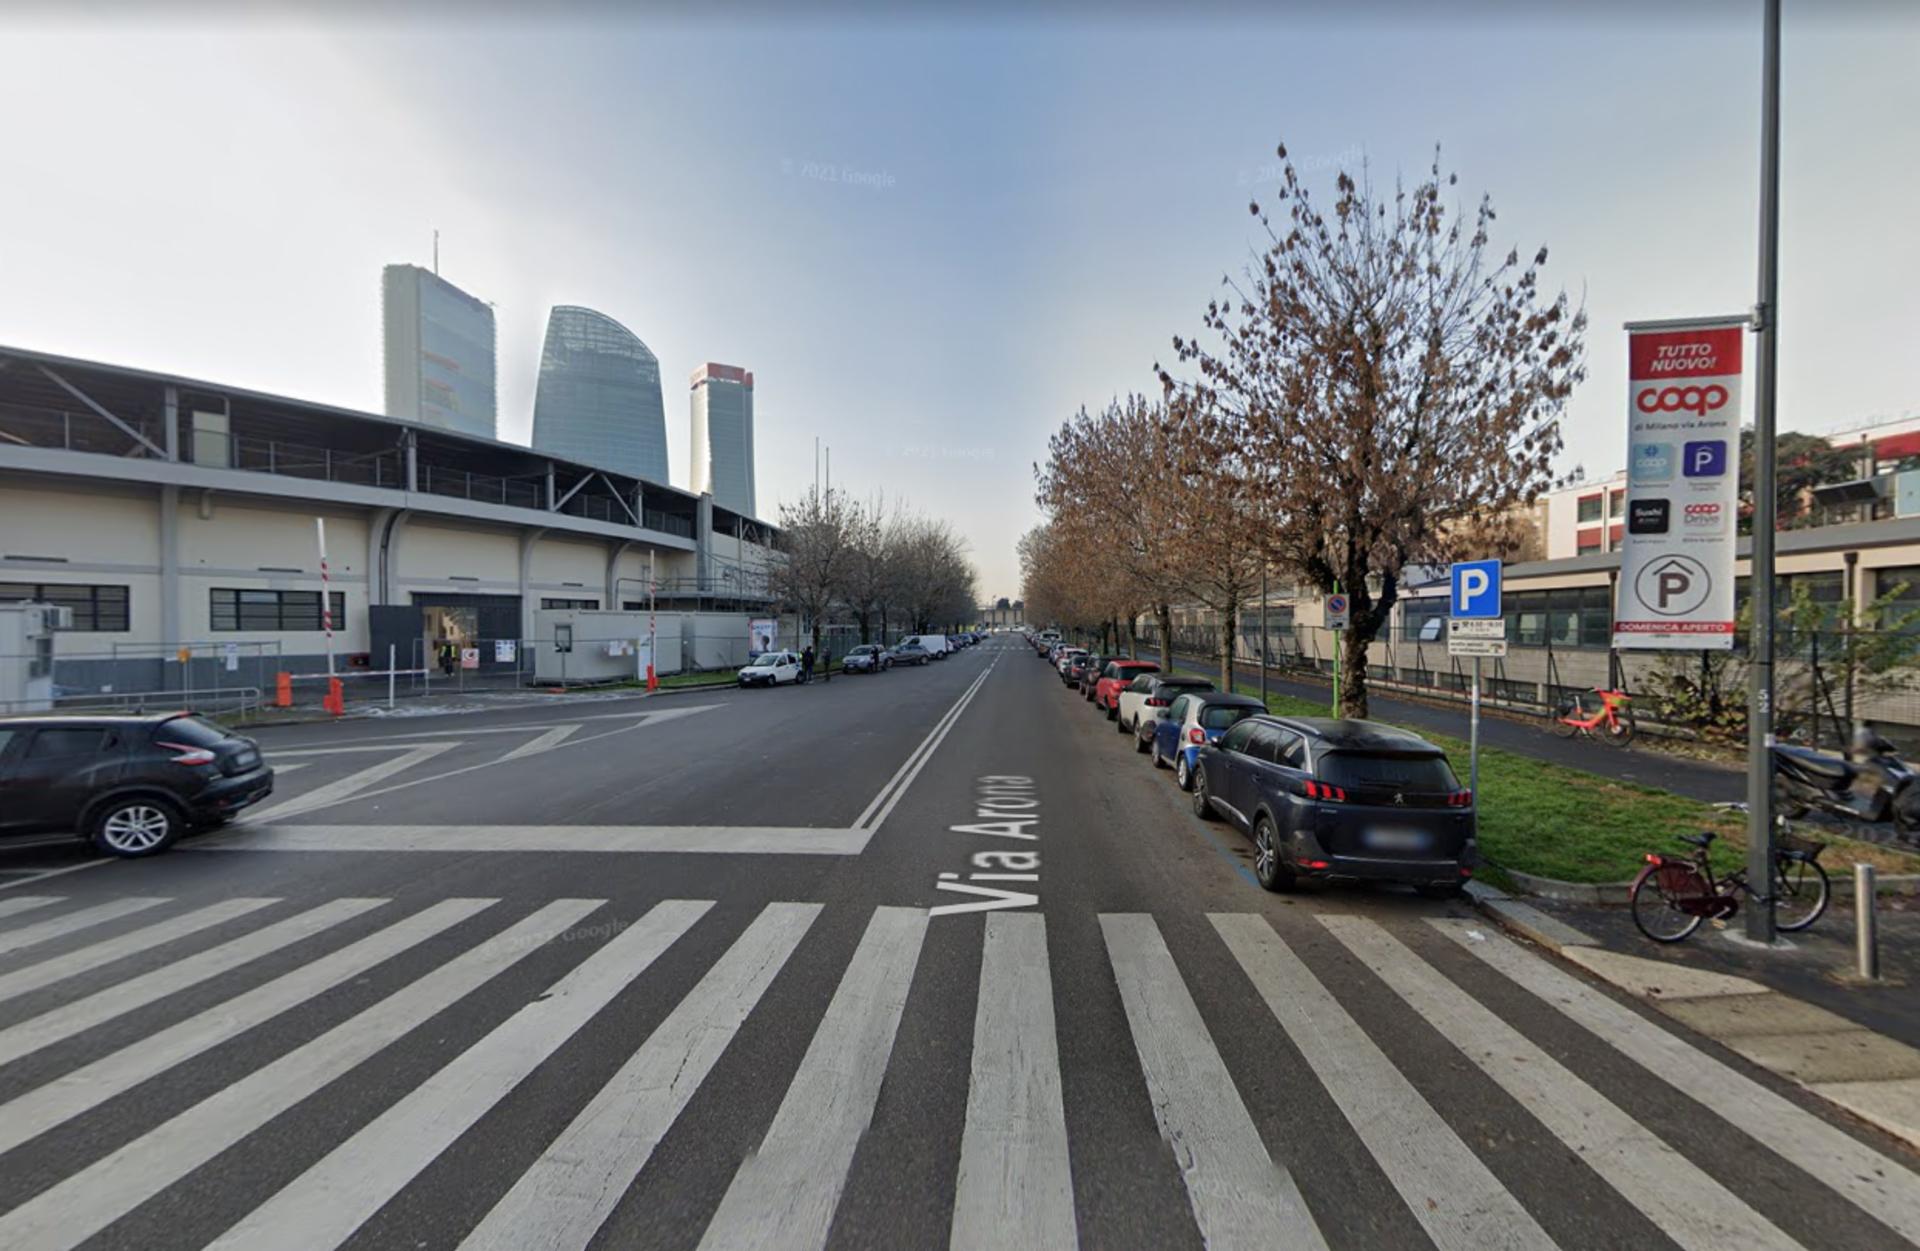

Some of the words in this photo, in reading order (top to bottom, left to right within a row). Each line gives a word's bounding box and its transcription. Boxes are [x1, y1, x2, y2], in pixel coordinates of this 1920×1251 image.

[1657, 343, 1712, 358] TUTTO
[1650, 356, 1717, 372] NUOVO!
[1636, 383, 1729, 417] coop
[1460, 568, 1490, 612] P
[1658, 572, 1690, 609] P
[1619, 622, 1679, 632] DOMENICA
[1681, 622, 1726, 632] APERTO
